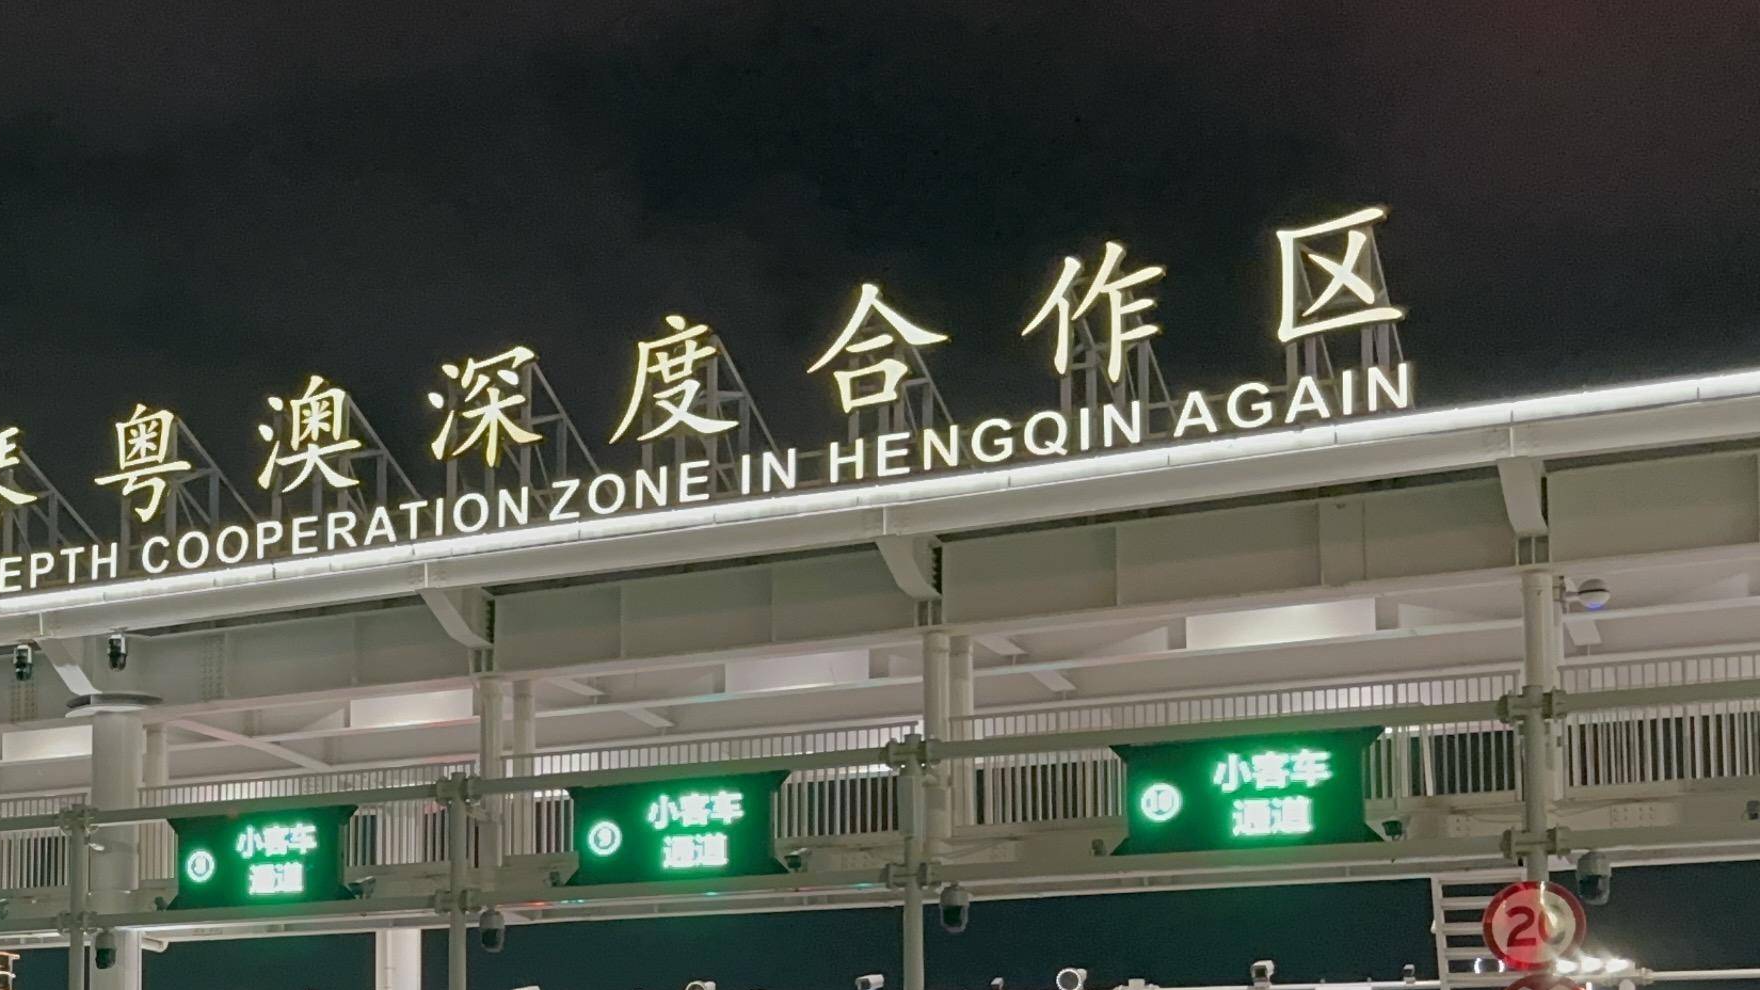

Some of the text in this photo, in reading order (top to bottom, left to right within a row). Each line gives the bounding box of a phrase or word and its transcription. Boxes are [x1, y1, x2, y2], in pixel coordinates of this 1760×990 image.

[141, 486, 529, 575] COOPERATION
[549, 460, 710, 523] ZONE
[741, 448, 797, 495] IN
[829, 400, 1142, 484] HENGQIN
[1173, 362, 1410, 438] AGAIN
